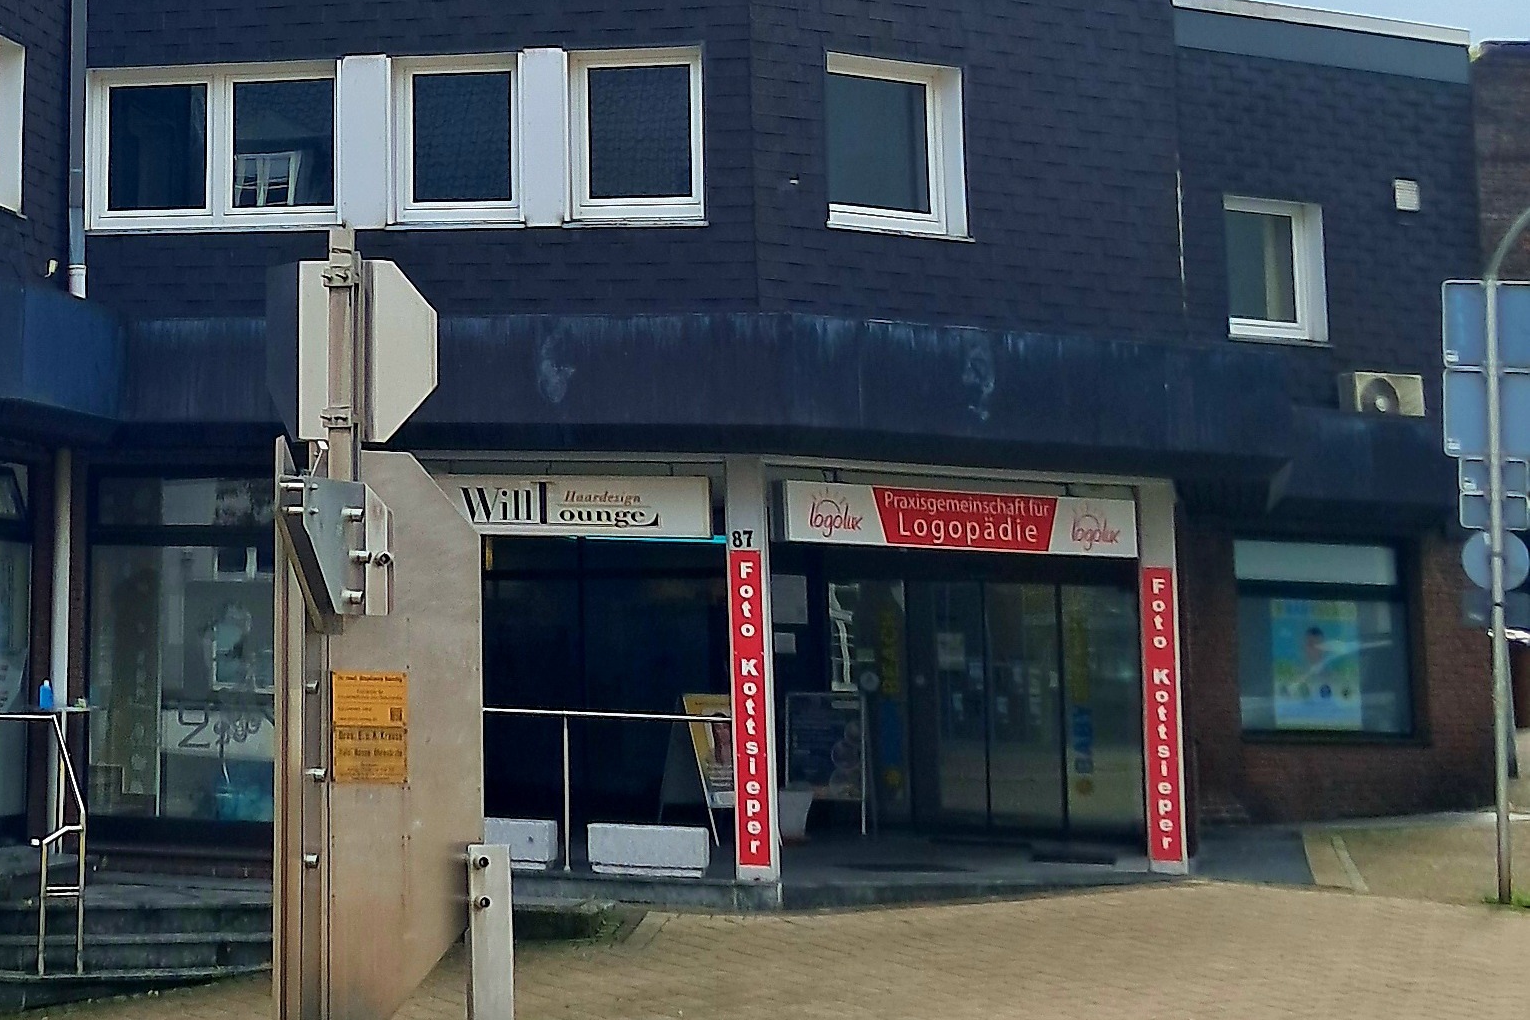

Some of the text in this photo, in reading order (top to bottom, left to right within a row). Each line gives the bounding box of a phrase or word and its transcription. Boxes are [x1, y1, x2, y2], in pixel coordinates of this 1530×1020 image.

[459, 485, 533, 524] Will
[884, 491, 1051, 518] Praxisgemeinschaft für
[731, 530, 755, 549] 87
[898, 512, 1039, 545] Logopädie
[738, 560, 764, 856] Foto Kottsieper
[1151, 577, 1175, 851] Foto Kottsieper
